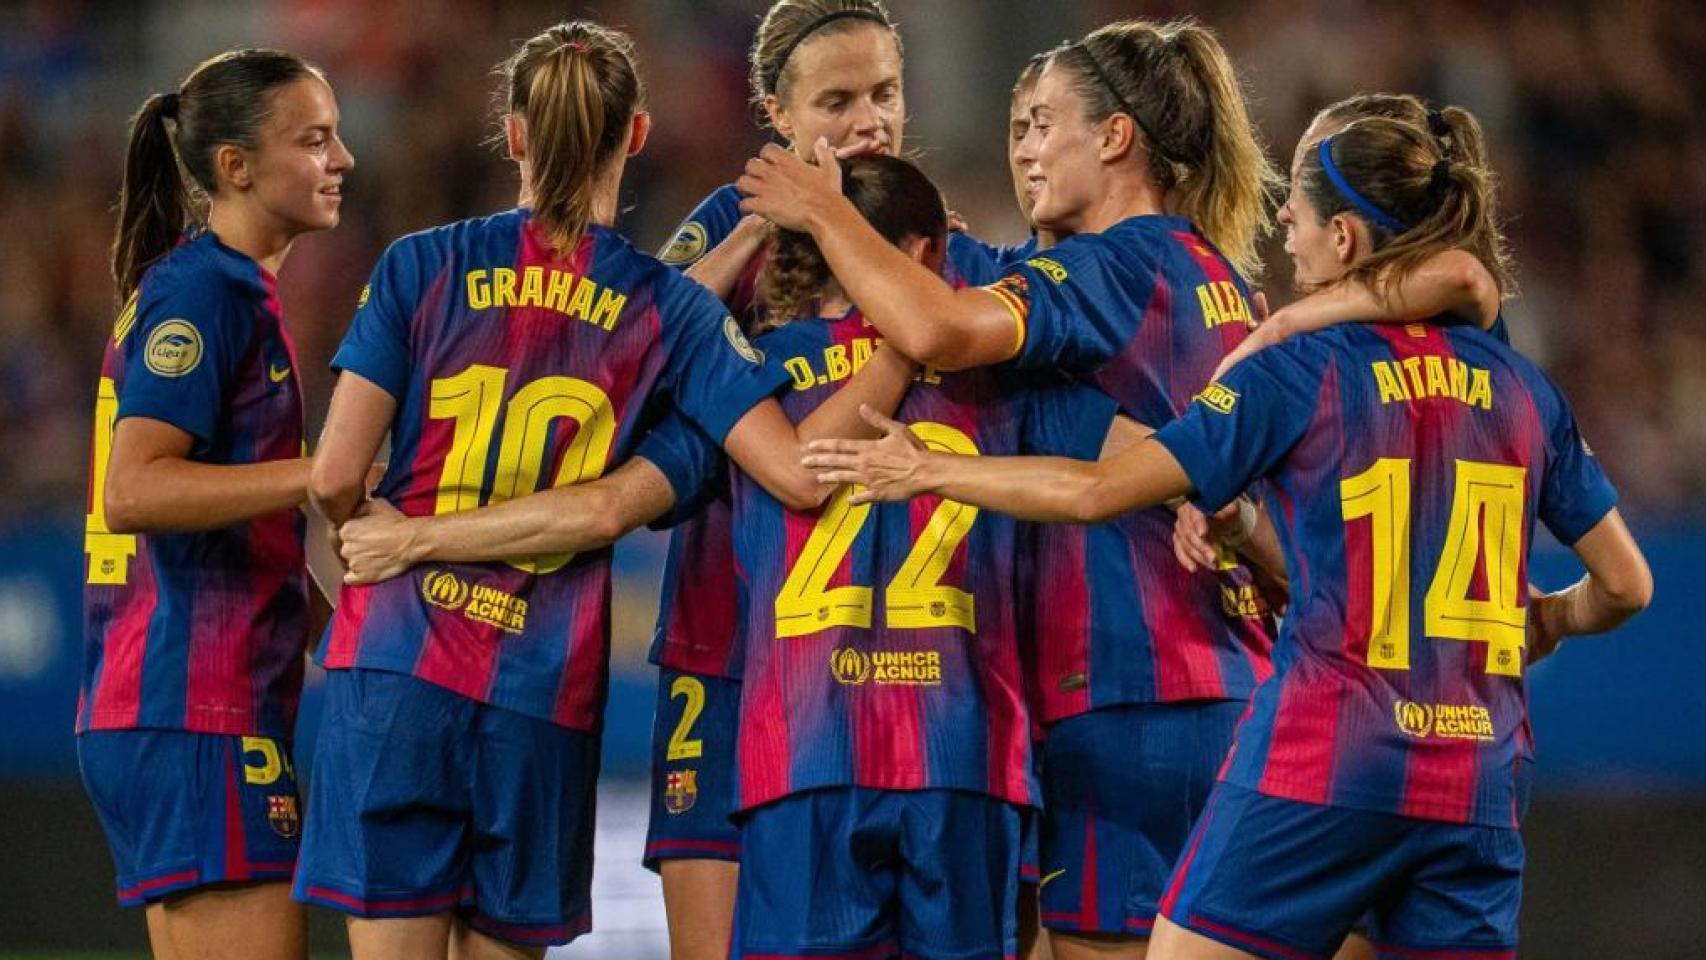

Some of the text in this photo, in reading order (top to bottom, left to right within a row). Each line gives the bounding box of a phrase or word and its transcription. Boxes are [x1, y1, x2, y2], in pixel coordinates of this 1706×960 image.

[466, 267, 627, 332] GRAHAM
[1371, 354, 1493, 411] AITANA
[430, 364, 617, 575] 10
[775, 421, 980, 639] 22
[1340, 457, 1527, 676] 14
[871, 651, 940, 666] UNHCR
[873, 666, 942, 680] ACNUR
[667, 676, 706, 760] 2
[1435, 703, 1491, 722] UNHCR
[1435, 719, 1493, 735] ACNUR
